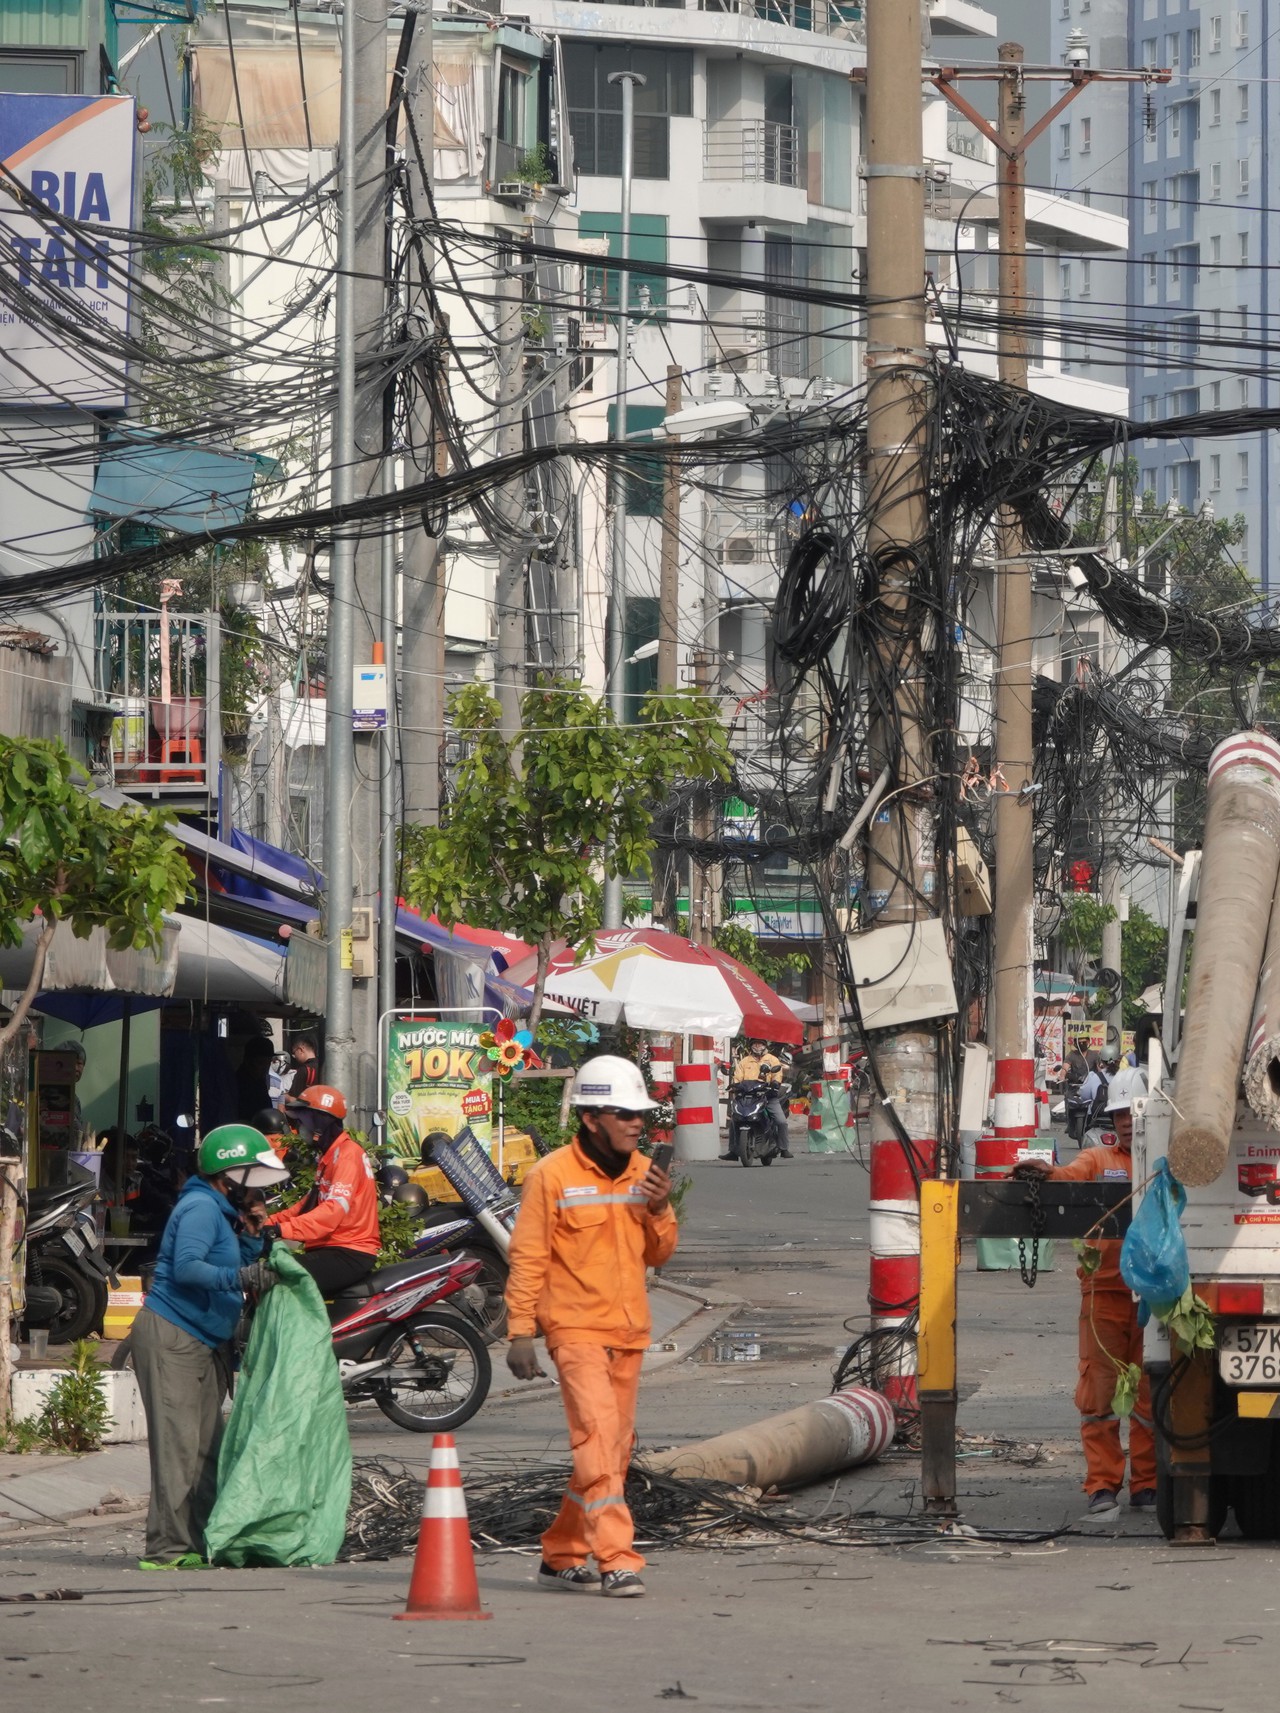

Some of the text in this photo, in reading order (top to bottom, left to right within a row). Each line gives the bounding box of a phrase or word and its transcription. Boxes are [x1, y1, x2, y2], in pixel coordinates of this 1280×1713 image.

[31, 171, 111, 222] BIA
[399, 1027, 480, 1050] NƯỚC MÍA
[405, 1047, 475, 1080] 10K
[464, 1101, 488, 1115] TẶNG 1
[466, 1093, 487, 1104] MUA 5
[216, 1144, 247, 1160] Grab
